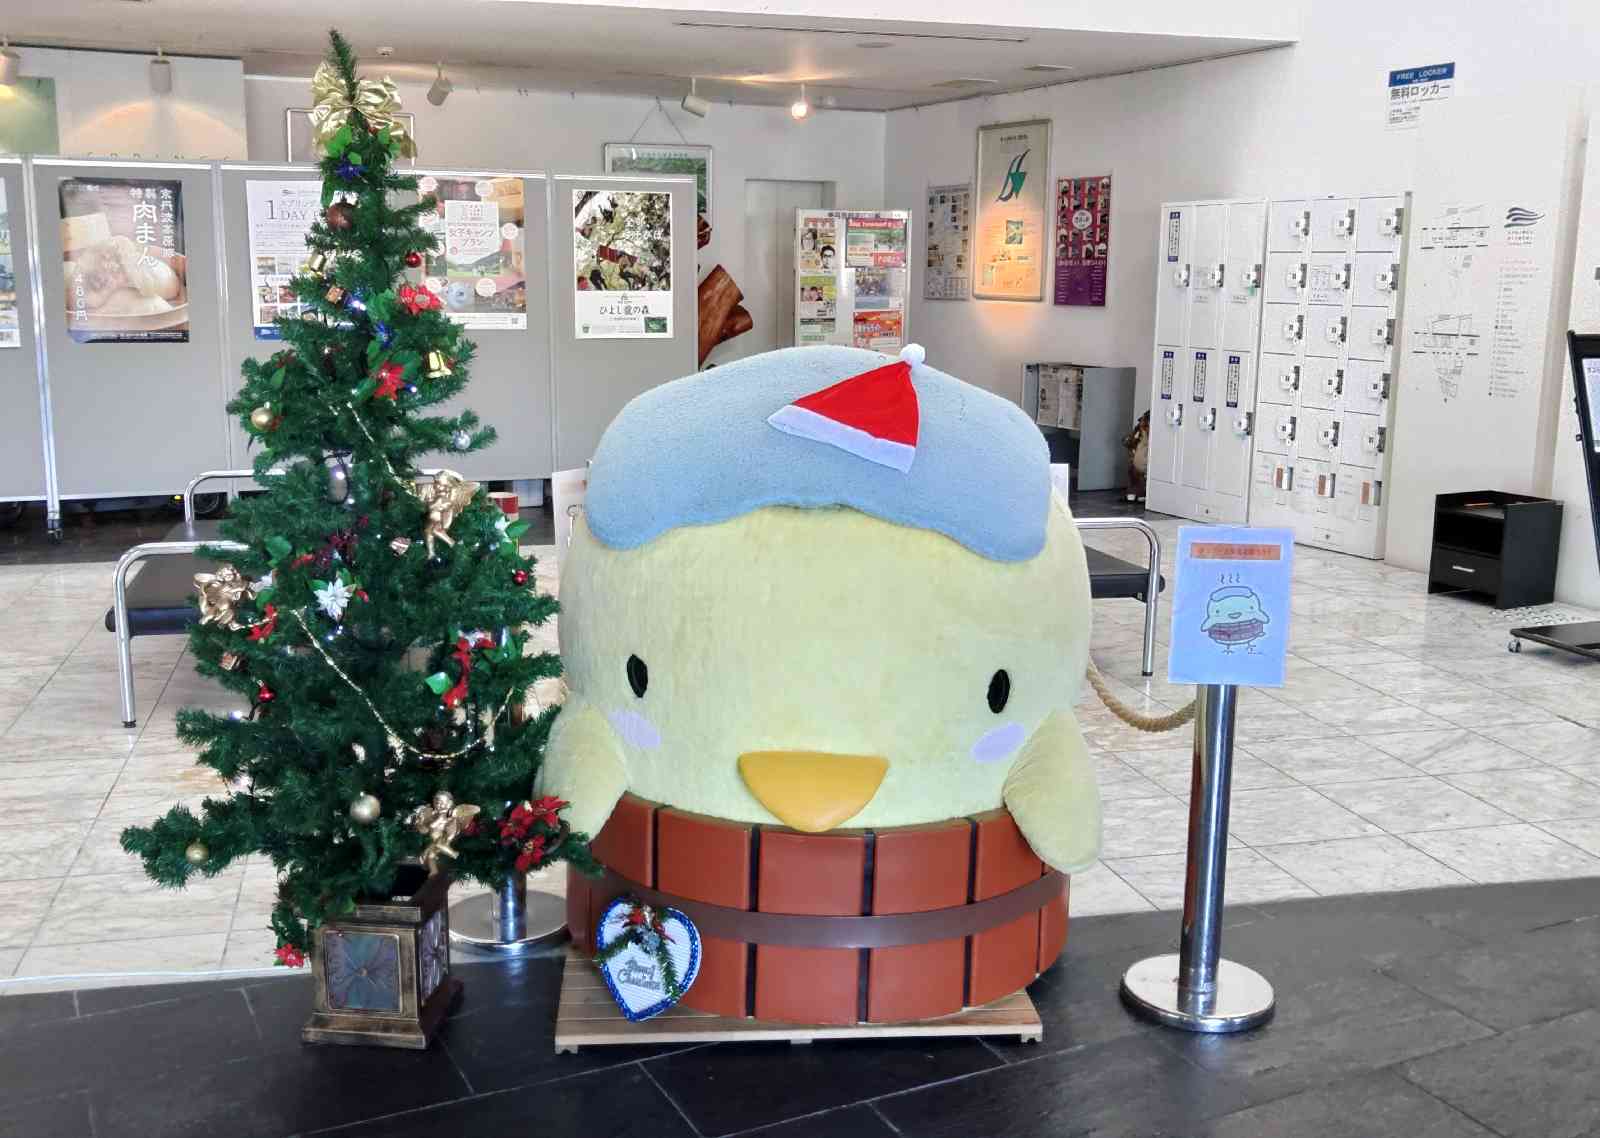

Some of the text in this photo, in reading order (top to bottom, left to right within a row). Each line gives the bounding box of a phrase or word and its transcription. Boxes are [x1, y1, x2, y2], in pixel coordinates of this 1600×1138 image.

[1391, 84, 1450, 100] 無料ロッカー
[133, 200, 159, 267] 肉まん
